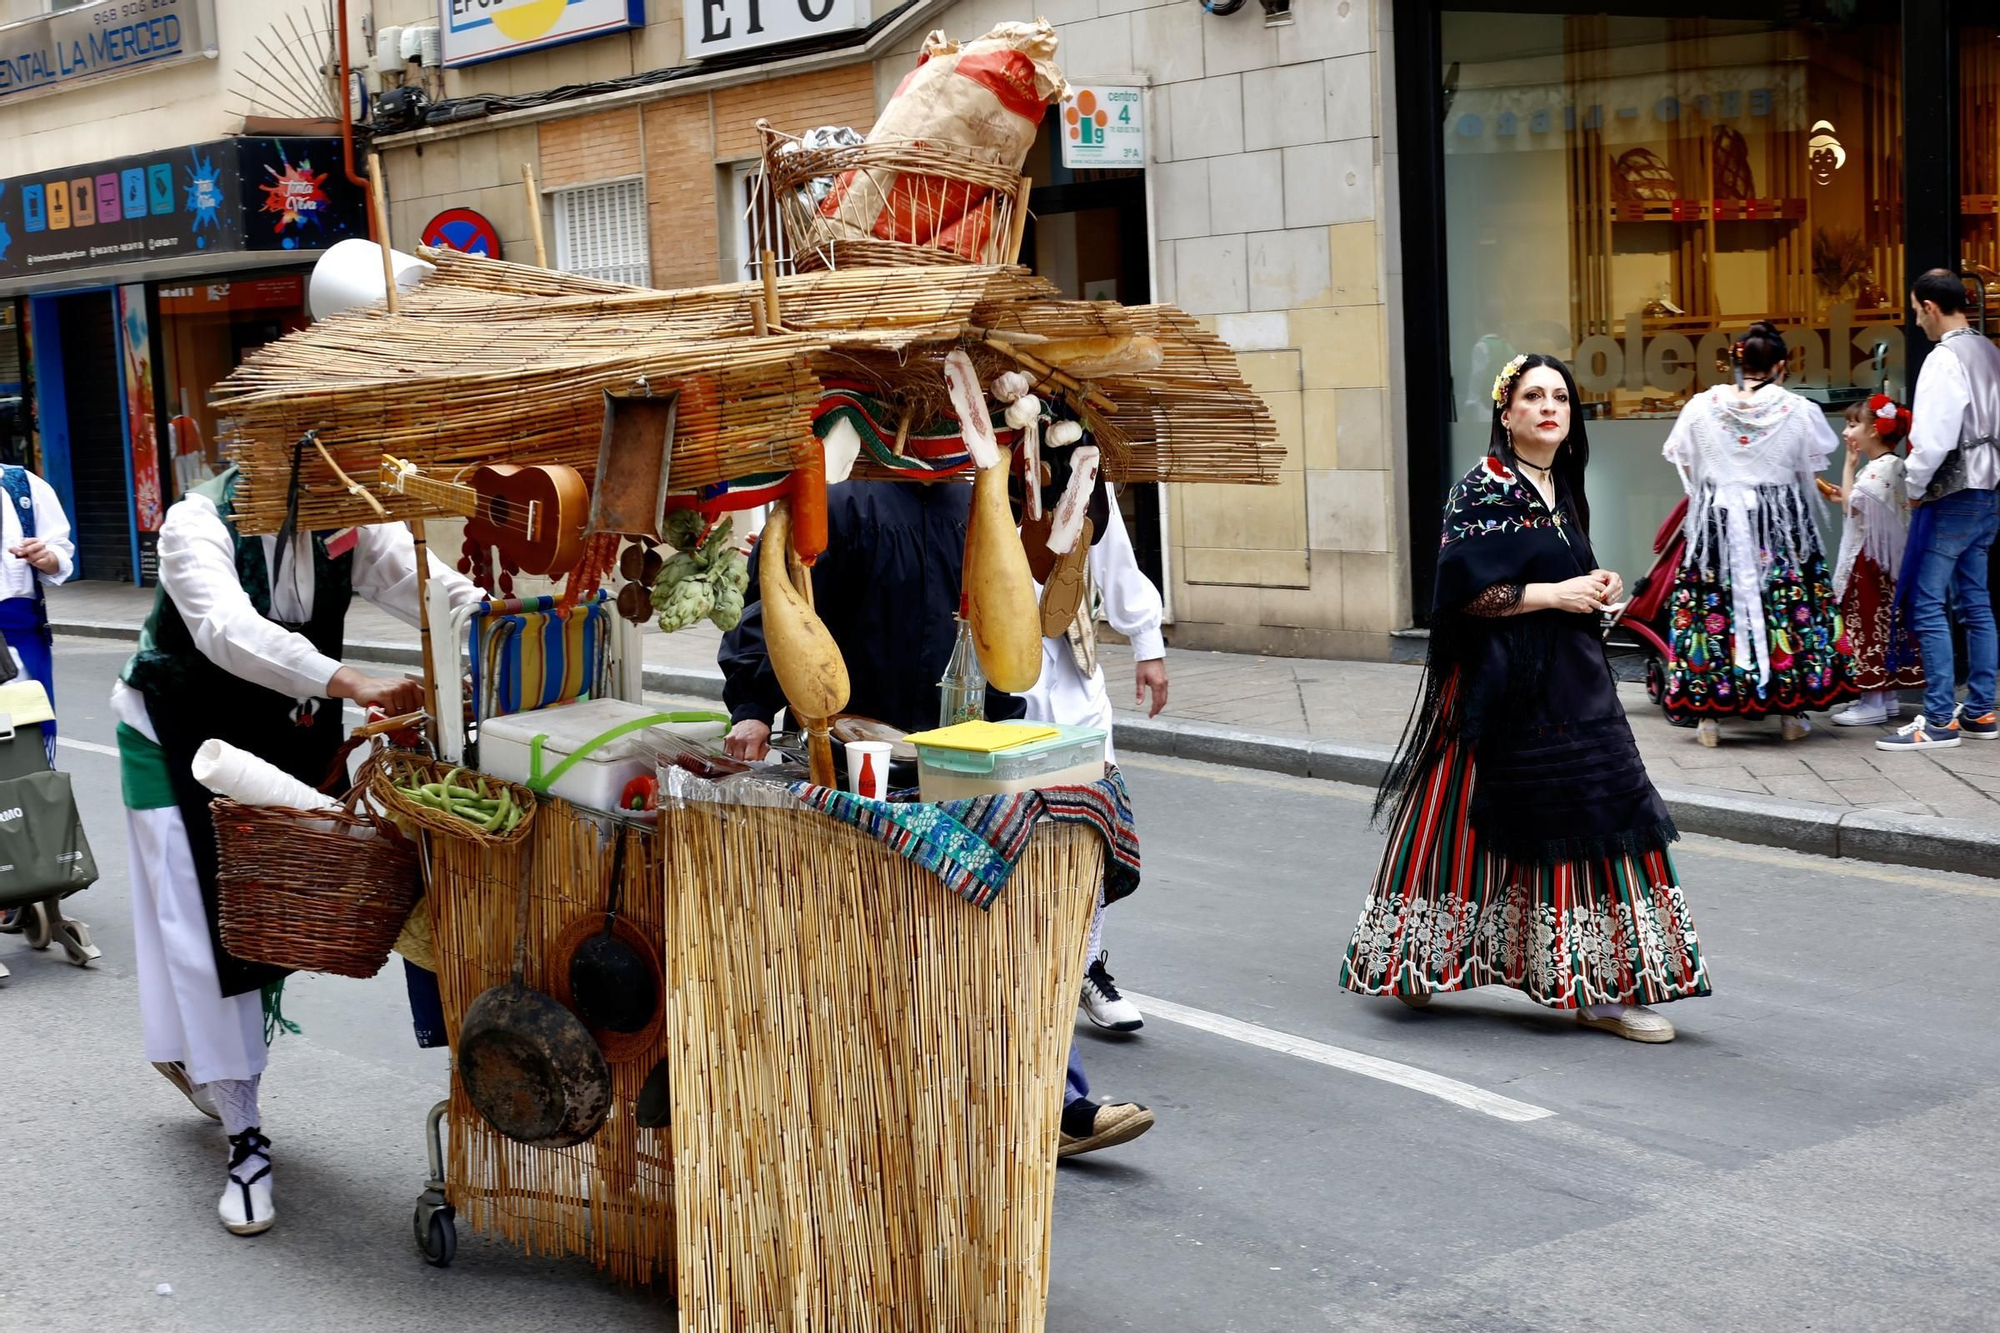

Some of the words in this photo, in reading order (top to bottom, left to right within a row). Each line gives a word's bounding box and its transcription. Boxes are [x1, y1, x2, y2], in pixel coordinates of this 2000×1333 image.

[57, 41, 88, 75] LA
[89, 14, 181, 67] MERCED
[1107, 90, 1138, 102] centro
[1119, 104, 1131, 125] 4
